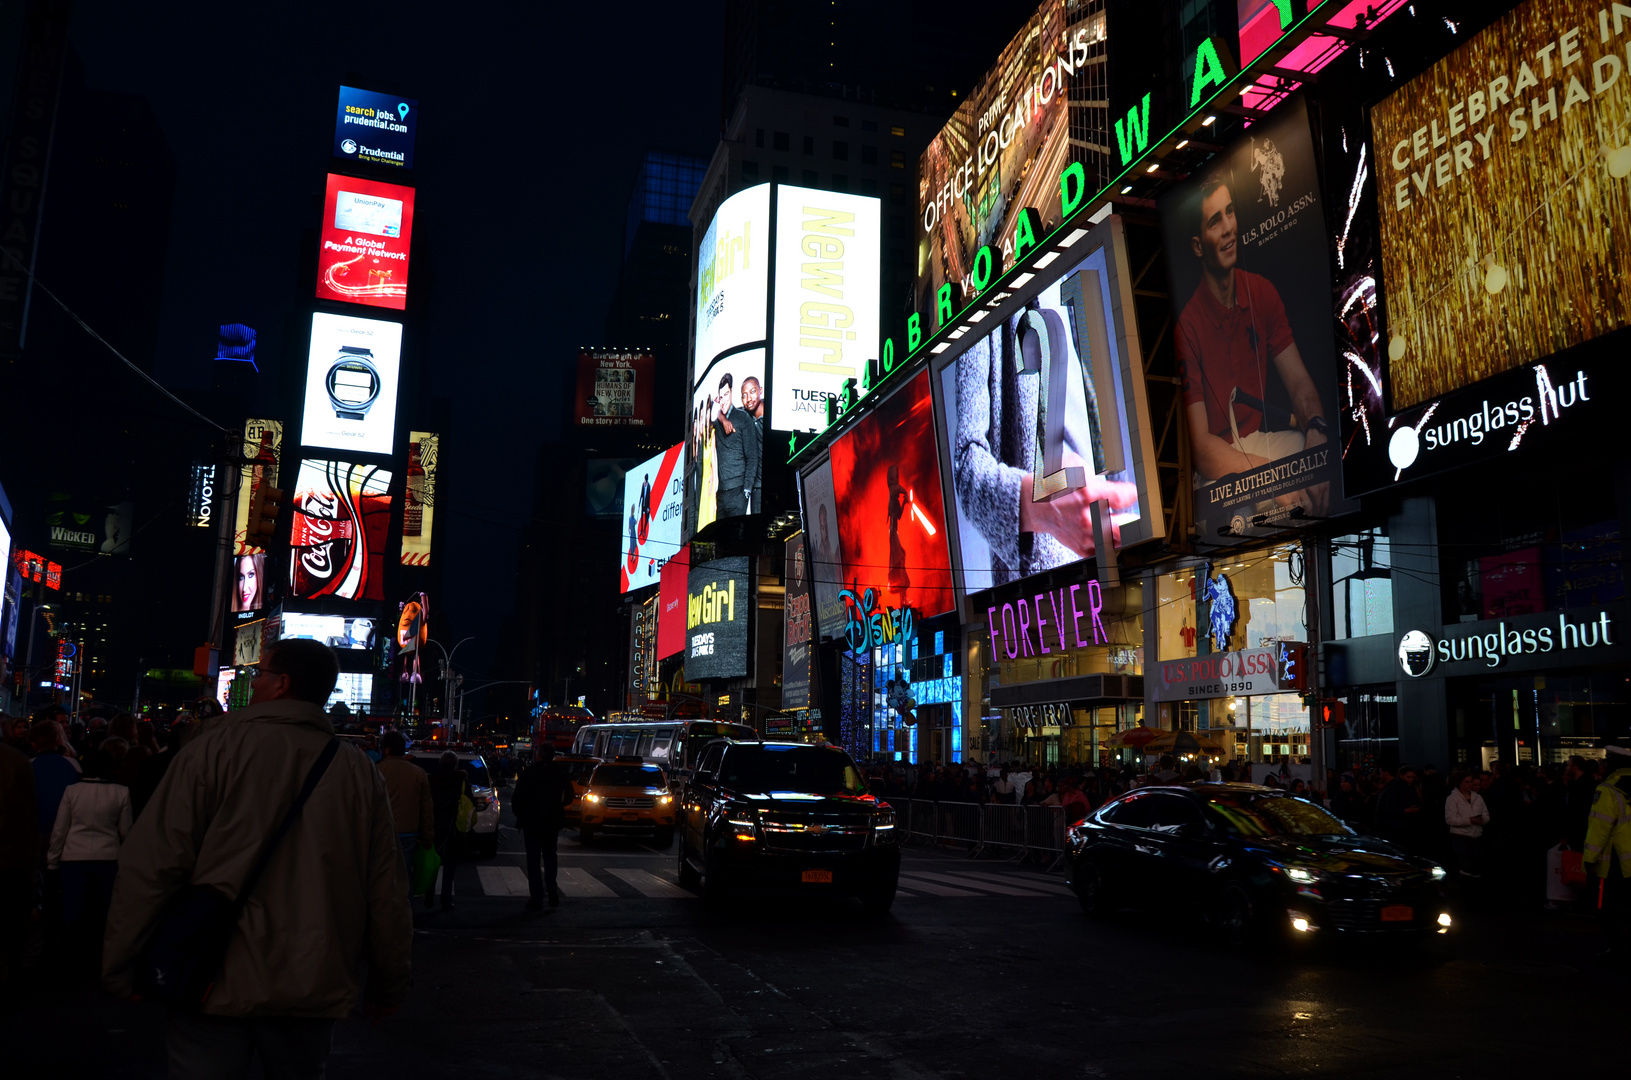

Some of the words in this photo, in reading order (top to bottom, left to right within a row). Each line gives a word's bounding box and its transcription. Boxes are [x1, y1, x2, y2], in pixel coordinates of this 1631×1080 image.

[1391, 26, 1582, 171] CELEBRATE
[344, 114, 408, 133] prudential.com
[345, 104, 375, 118] search
[375, 108, 396, 122] jobs.
[978, 91, 1008, 137] PRIME
[1395, 124, 1495, 212] EVERY
[1509, 41, 1631, 143] SHAD
[924, 158, 973, 232] OFFICE
[978, 28, 1088, 177] LOCATIONS
[359, 145, 405, 161] Prudential
[370, 155, 380, 163] Your
[354, 198, 386, 209] UnionPay
[1242, 228, 1259, 246] U.S.
[1260, 210, 1286, 235] POLO
[1287, 192, 1317, 218] ASSN.
[1258, 229, 1278, 246] SINCE
[1280, 218, 1298, 233] 1890
[324, 240, 366, 255] Payment
[367, 248, 406, 261] Network
[355, 237, 386, 249] Global
[716, 221, 752, 284] Girl
[799, 301, 856, 376] Girl
[600, 360, 614, 368] New
[596, 382, 622, 390] HUMANS
[623, 382, 631, 390] OF
[596, 389, 612, 397] NEW
[826, 338, 894, 426] 1540
[792, 389, 845, 403] TUESDA
[792, 402, 817, 413] JAN
[581, 416, 594, 424] One
[595, 417, 612, 425] story
[628, 417, 645, 426] time.
[1425, 396, 1534, 450] sunglass
[1209, 483, 1233, 504] LIVE
[1234, 450, 1329, 496] AUTHENTICALLY
[1282, 480, 1296, 489] POLO
[702, 579, 735, 624] Girl
[988, 579, 1108, 662] FOREVER
[633, 611, 643, 689] PALACE
[1437, 621, 1553, 668] sunglass
[1559, 611, 1615, 650] hut
[1164, 663, 1188, 684] U.S.
[1191, 657, 1232, 681] POLO
[1188, 684, 1220, 695] SINCE
[1224, 681, 1253, 692] 1890
[1011, 701, 1059, 729] FOREVER
[1059, 702, 1073, 726] 21
